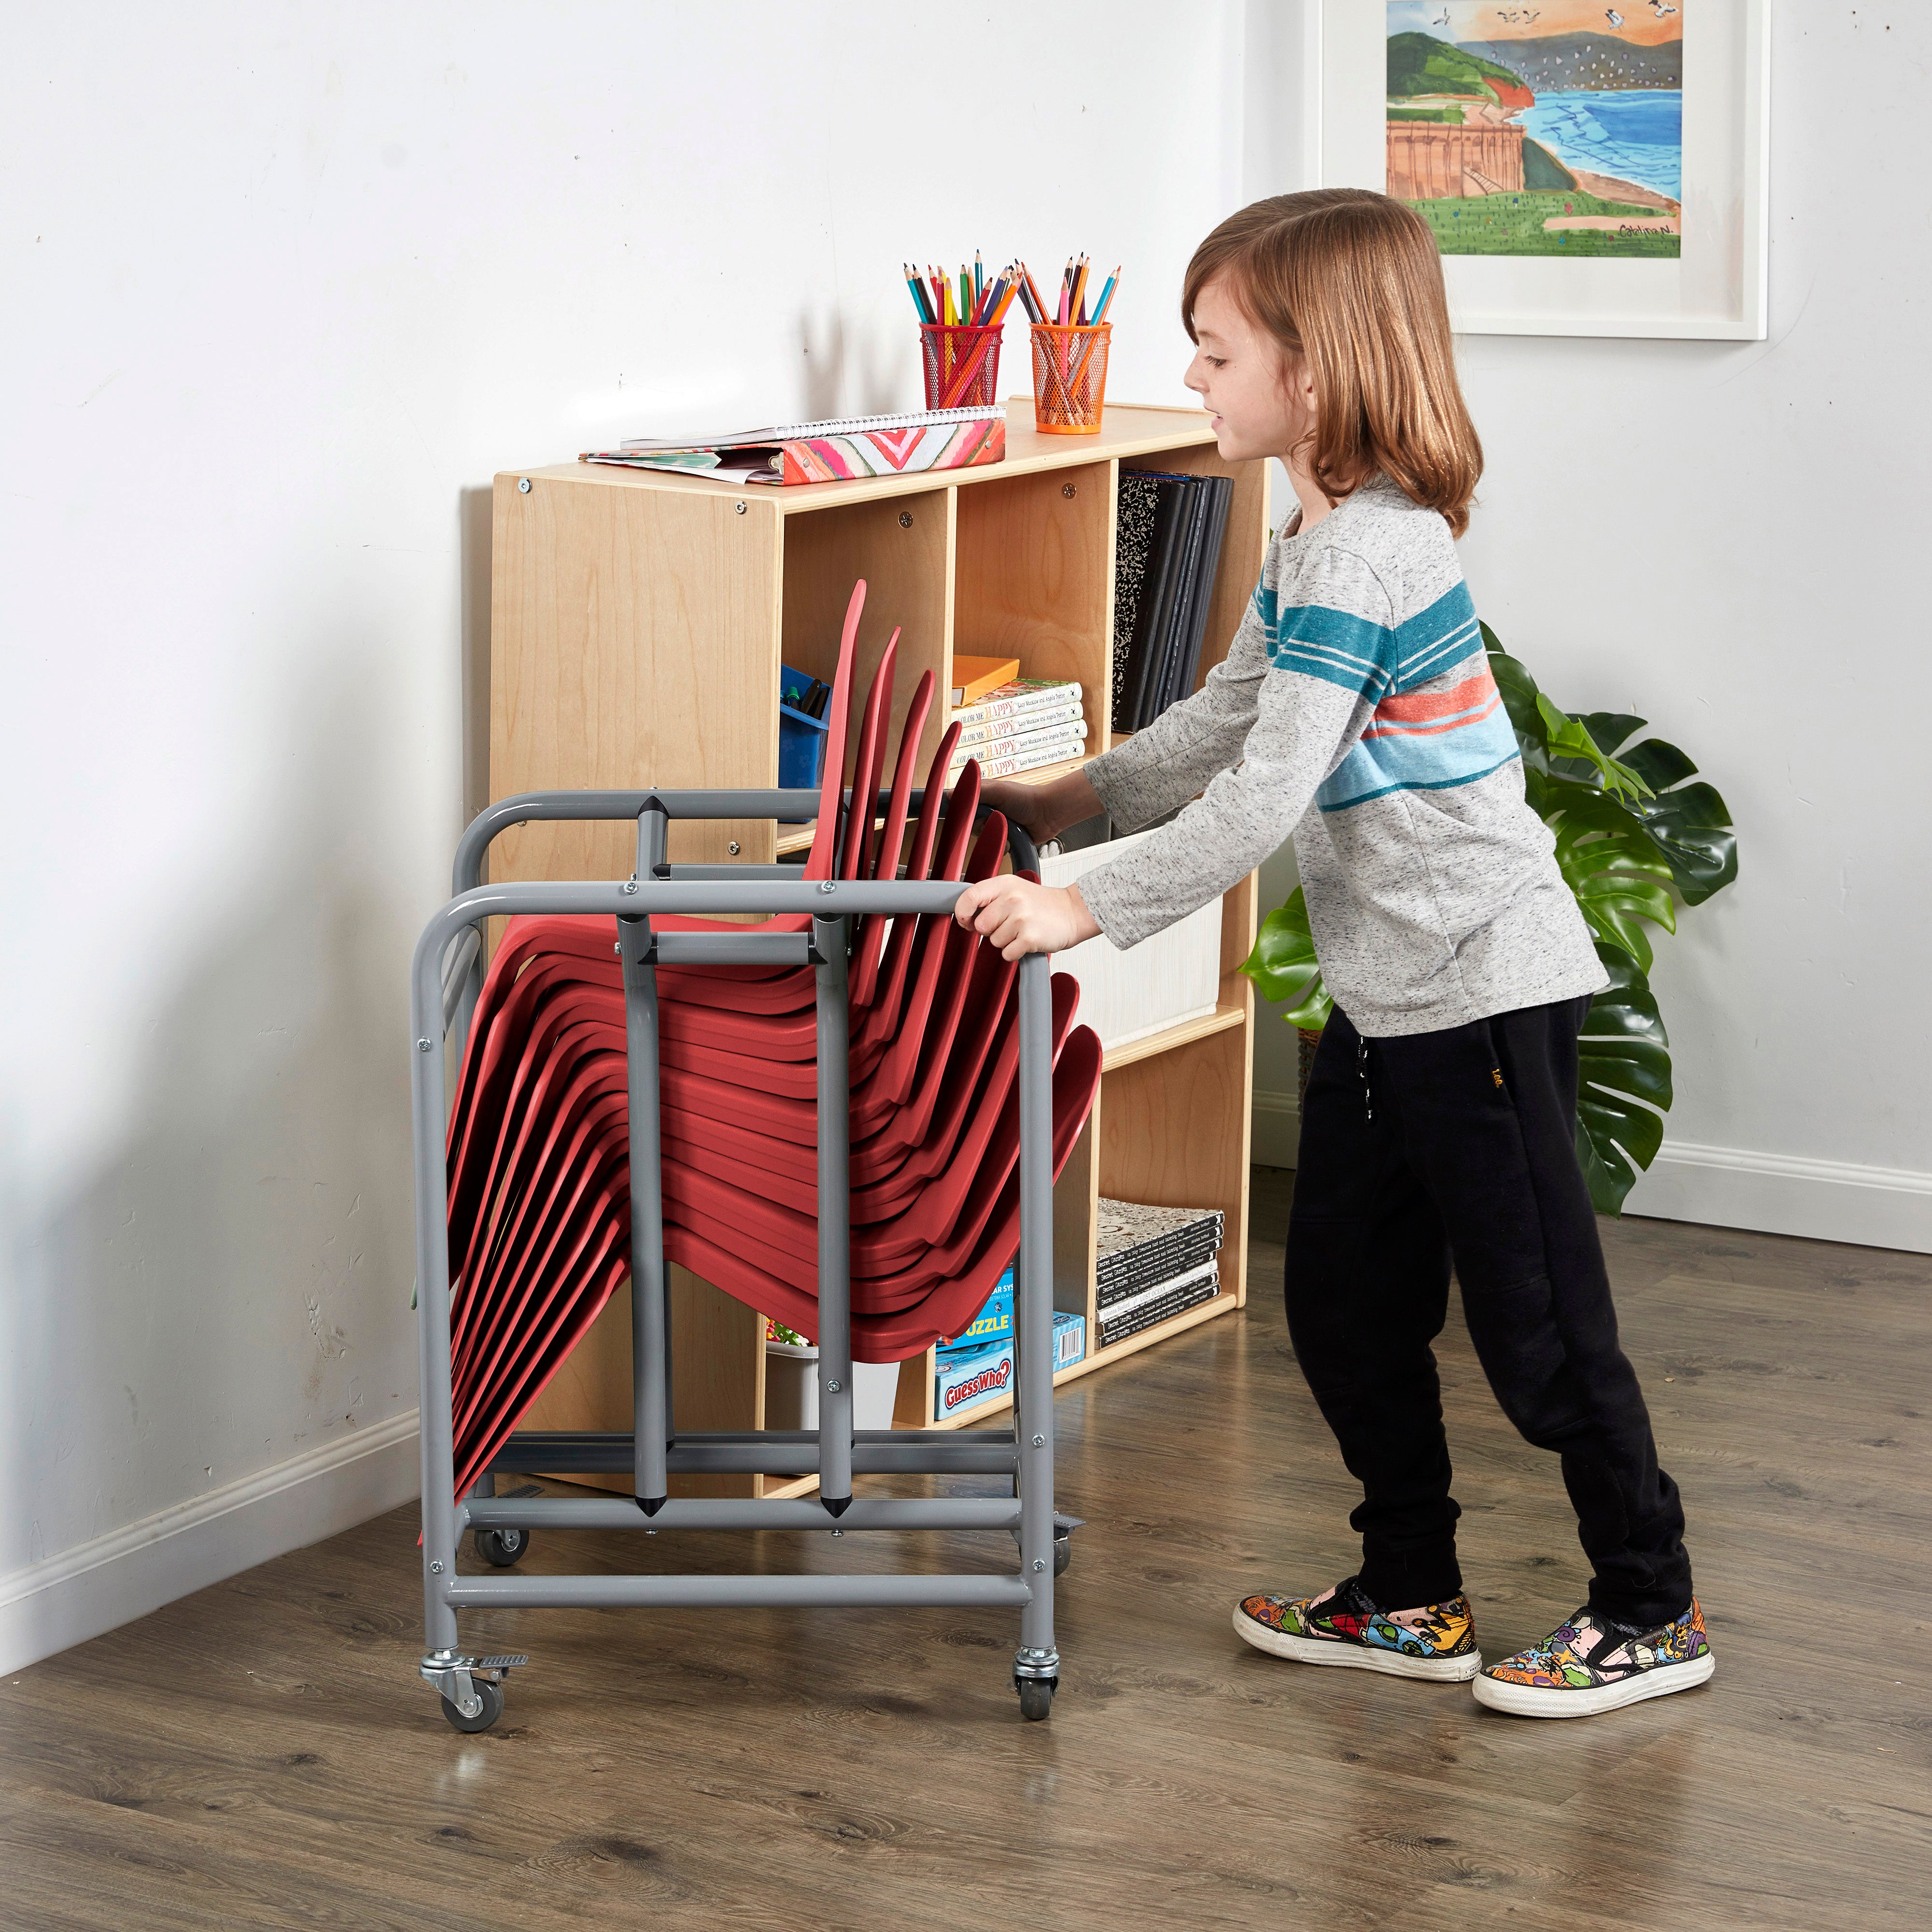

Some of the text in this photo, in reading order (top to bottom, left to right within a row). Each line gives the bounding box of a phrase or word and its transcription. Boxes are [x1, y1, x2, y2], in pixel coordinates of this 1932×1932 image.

[1619, 224, 1659, 238] Catalina
[976, 712, 984, 721] ME
[984, 701, 1013, 719] HAPPY
[976, 731, 984, 740] ME
[984, 720, 1013, 738] HAPPY
[976, 751, 984, 760] ME
[985, 739, 1015, 758] HAPPY
[986, 759, 1015, 777] HAPPY
[1492, 1068, 1503, 1085] Lee
[1097, 1260, 1110, 1268] Secret
[1111, 1254, 1124, 1263] Garden
[1101, 1272, 1113, 1281] Secret
[1114, 1267, 1127, 1276] Garden
[992, 1286, 1002, 1295] AR
[1102, 1284, 1114, 1293] Secret
[1115, 1279, 1128, 1288] Garden
[1101, 1296, 1113, 1306] Secret
[1113, 1291, 1126, 1300] Garden
[1104, 1286, 1166, 1319] Johanna Basford LOST OCEAN
[965, 1314, 1009, 1336] UZZLE
[1108, 1320, 1119, 1329] Secret
[1119, 1315, 1132, 1323] Garden
[1105, 1334, 1117, 1343] Secret
[1117, 1329, 1130, 1337] Garden
[945, 1360, 1010, 1407] Guess Who?
